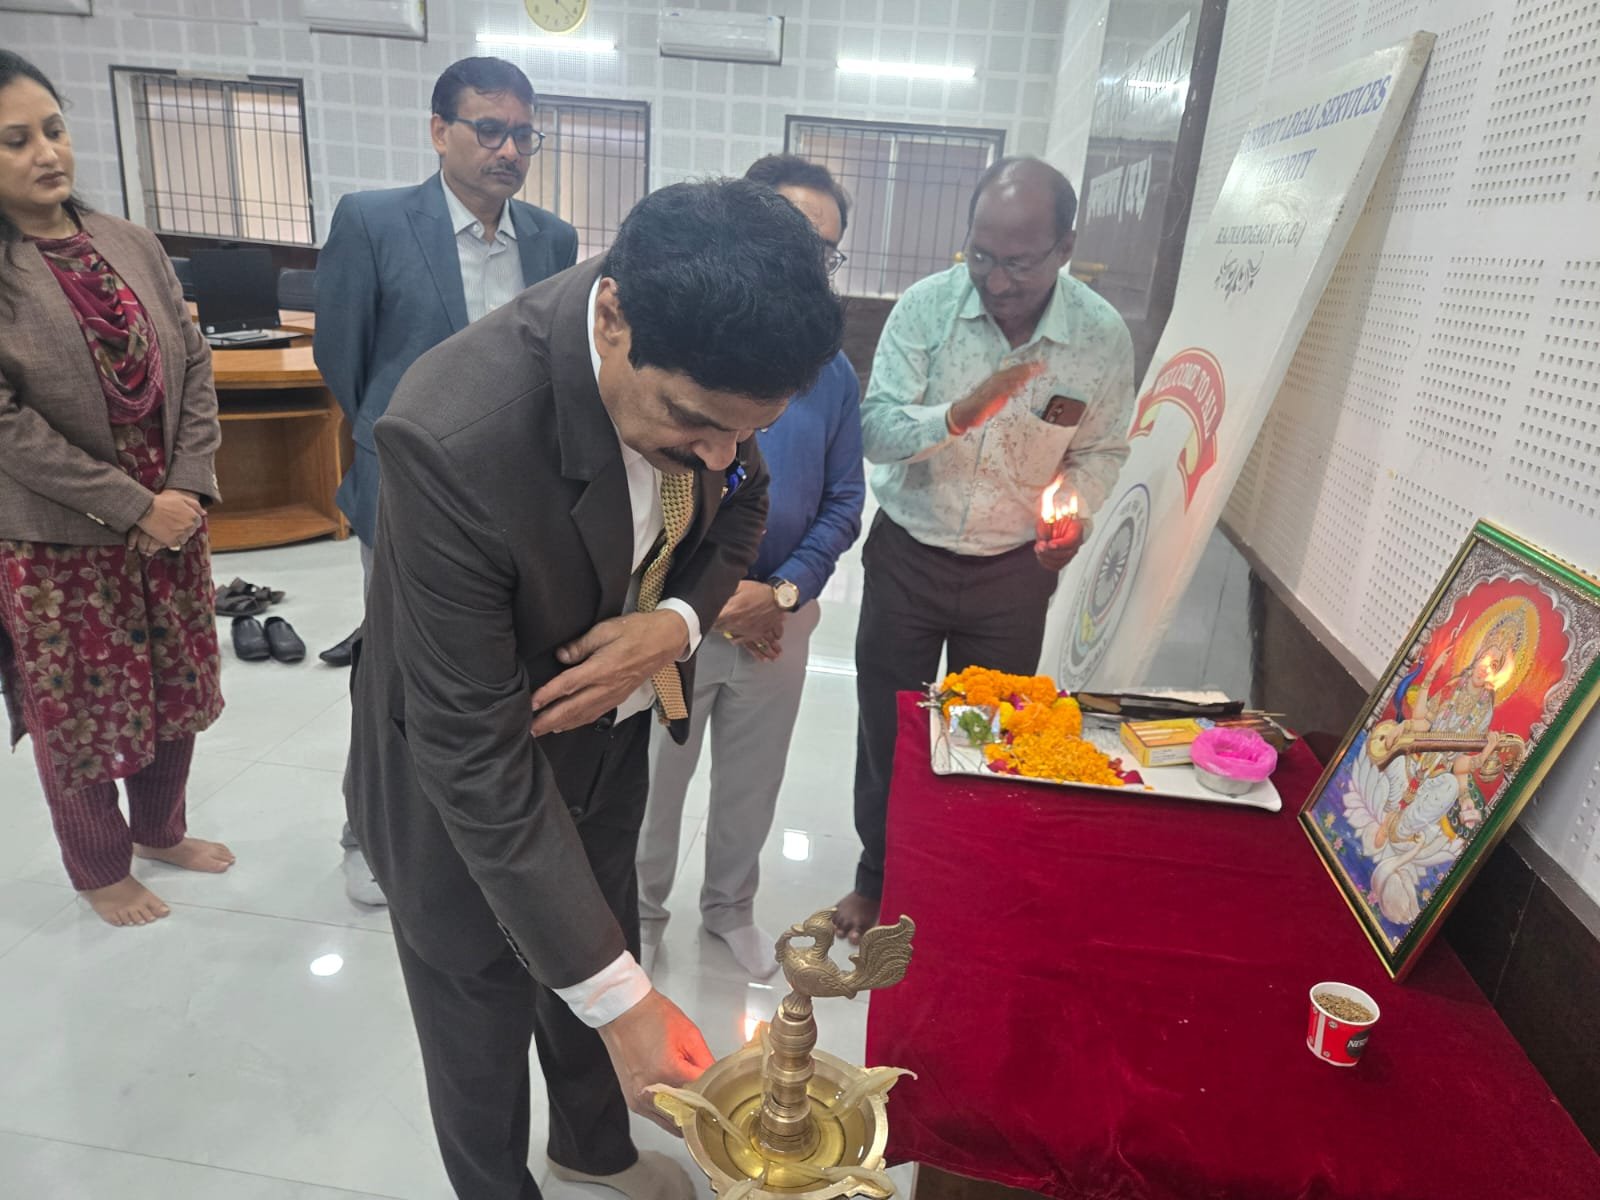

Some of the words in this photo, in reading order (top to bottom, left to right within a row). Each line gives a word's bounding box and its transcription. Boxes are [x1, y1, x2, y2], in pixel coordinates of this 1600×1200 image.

[1279, 103, 1321, 141] LEGAL
[1315, 74, 1393, 130] SERVICES
[1258, 147, 1318, 187] THORITY
[1153, 362, 1201, 396] WELCOME
[1194, 369, 1210, 402] TO
[1201, 389, 1217, 439] ALL
